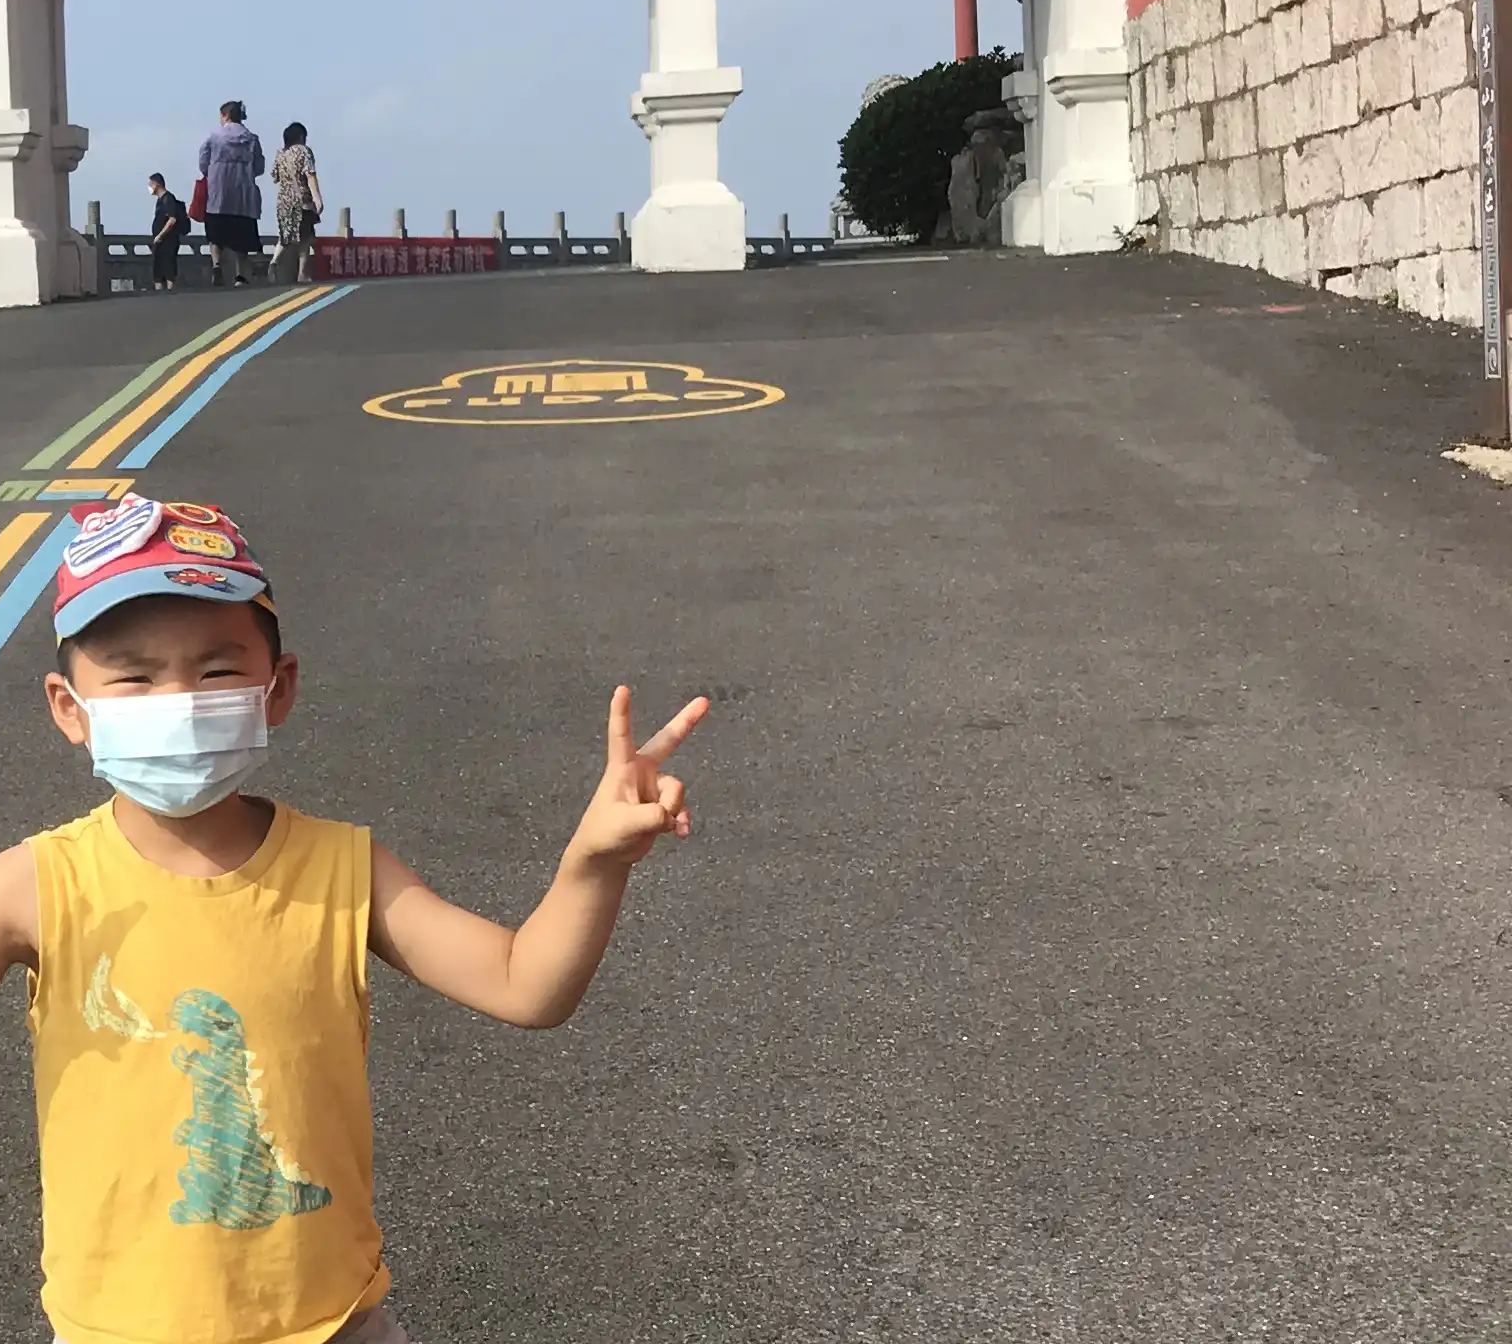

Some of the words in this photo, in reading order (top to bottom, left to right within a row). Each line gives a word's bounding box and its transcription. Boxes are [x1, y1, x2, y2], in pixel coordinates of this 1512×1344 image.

[1480, 23, 1496, 214] 茅山景区
[403, 390, 745, 408] FUDAO
